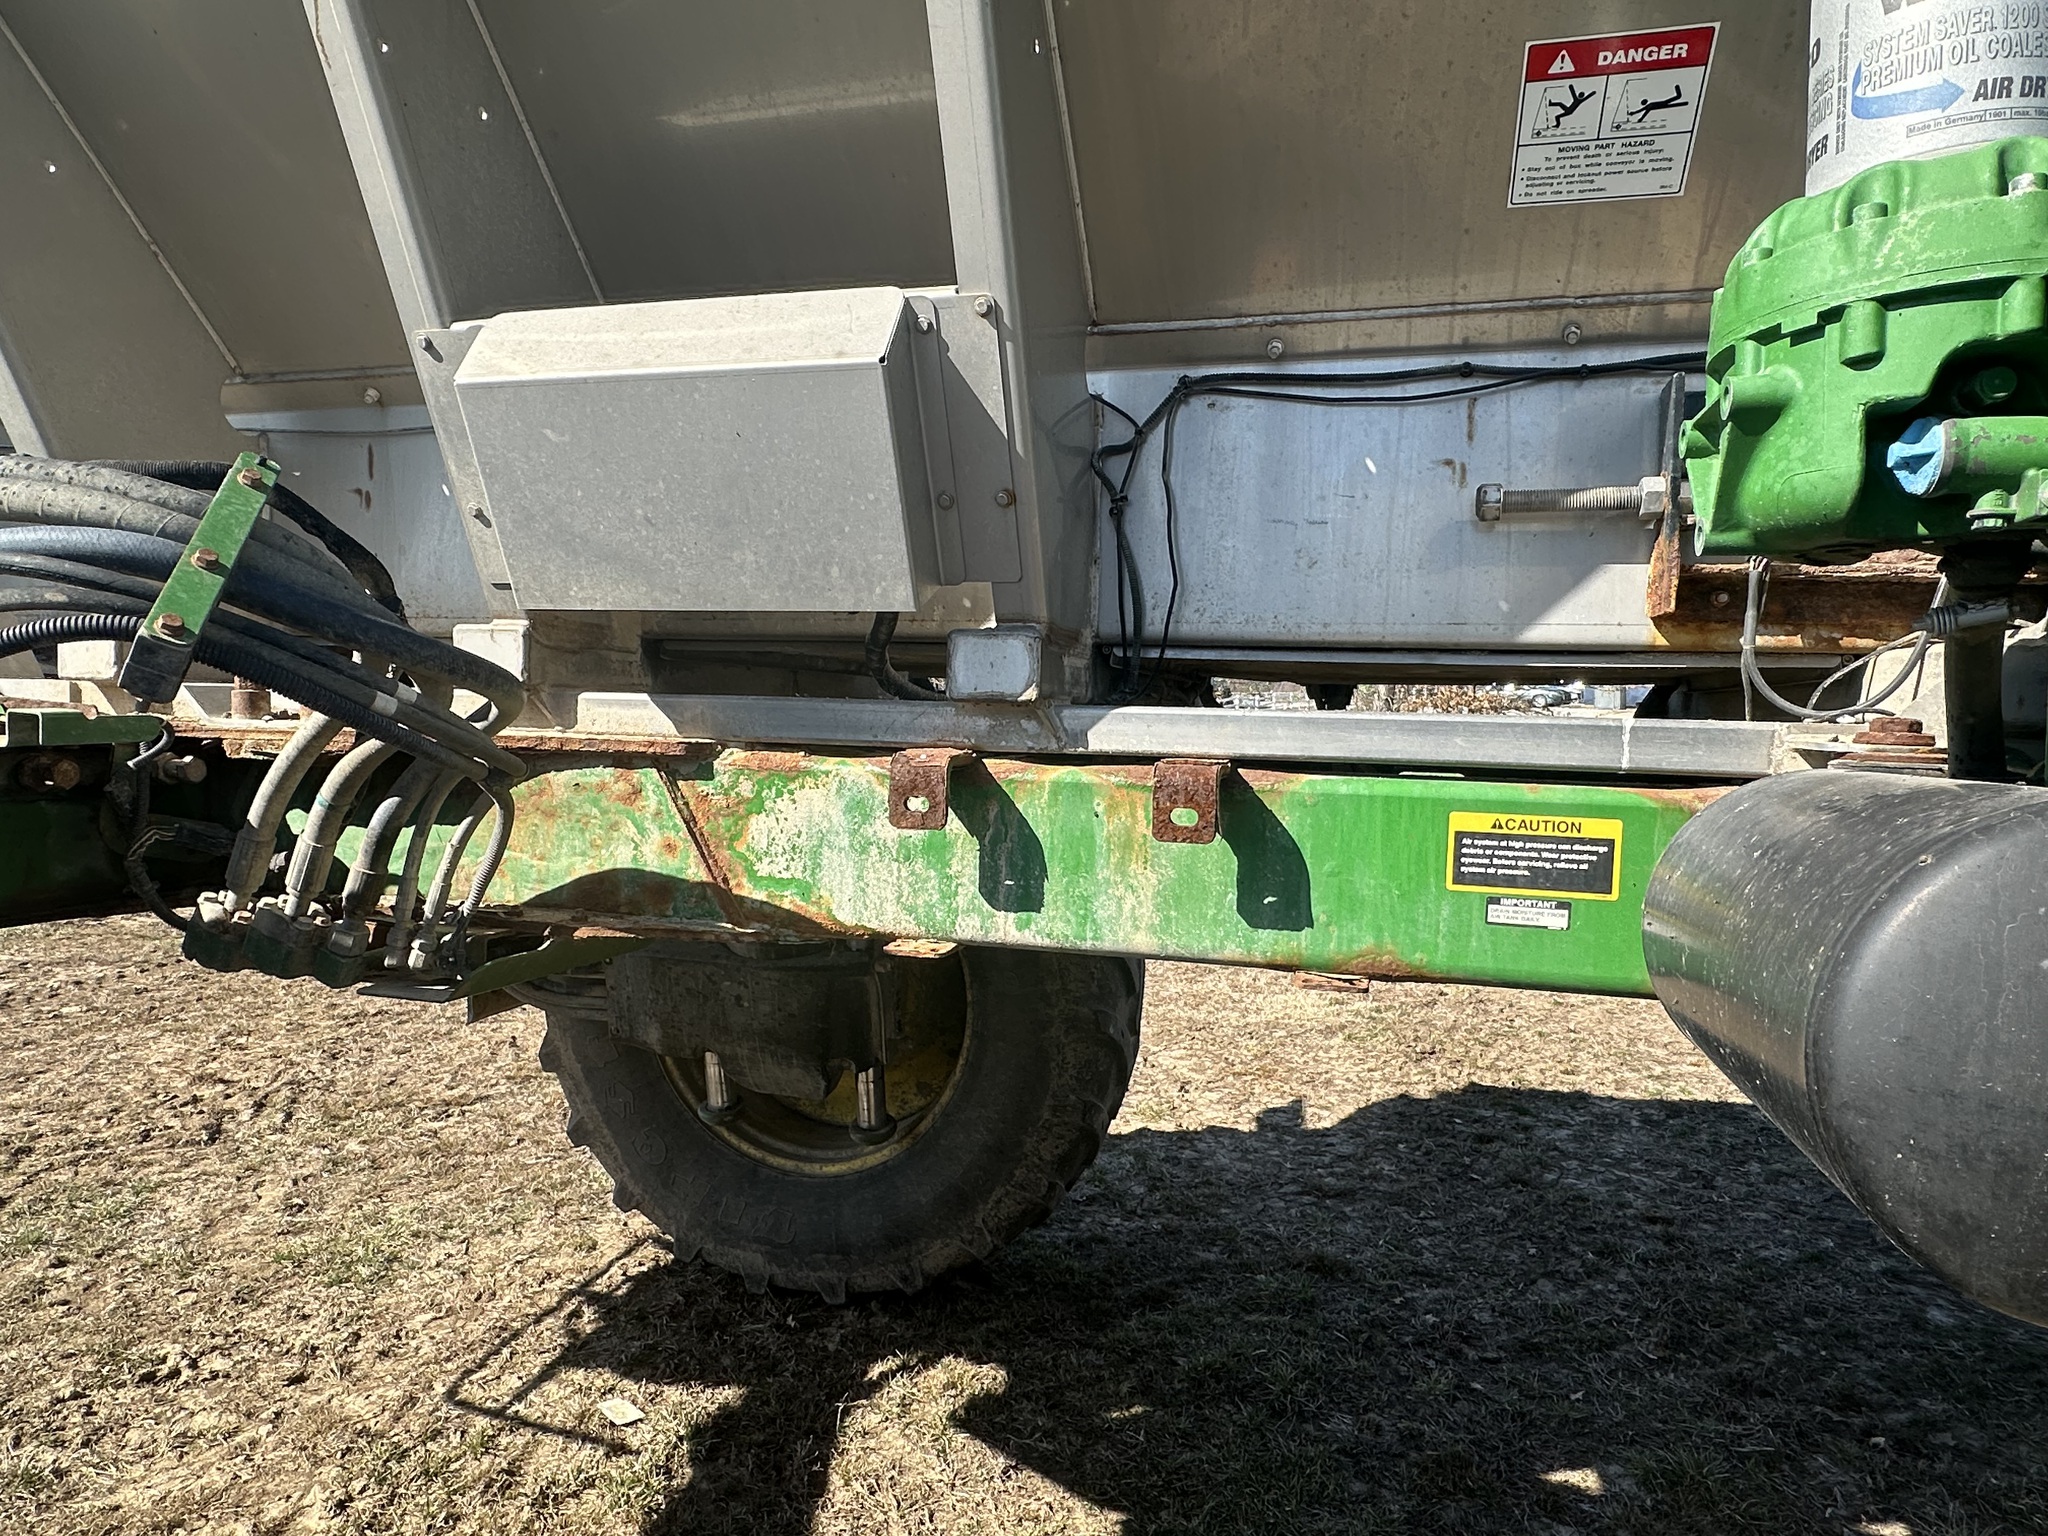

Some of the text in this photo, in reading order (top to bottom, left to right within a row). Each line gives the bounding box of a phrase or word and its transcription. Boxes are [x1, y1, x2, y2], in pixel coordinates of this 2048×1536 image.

[1863, 19, 1930, 68] SYSTEM
[2001, 2, 2040, 30] 1200
[1597, 43, 1689, 66] DANGER
[1861, 44, 1943, 96] PREMIUM
[1949, 38, 1980, 66] OIL
[1972, 75, 2048, 102] AIR DR
[1909, 123, 1932, 134] Made
[1933, 119, 1942, 129] in
[1944, 114, 1984, 126] Germany
[1558, 139, 1656, 153] MOVING PART HAZARD
[1556, 154, 1580, 162] prevent
[1505, 818, 1582, 834] CAUTION
[1508, 840, 1524, 849] high
[1500, 897, 1558, 909] IMPORTANT
[1512, 909, 1546, 917] MOISTURE
